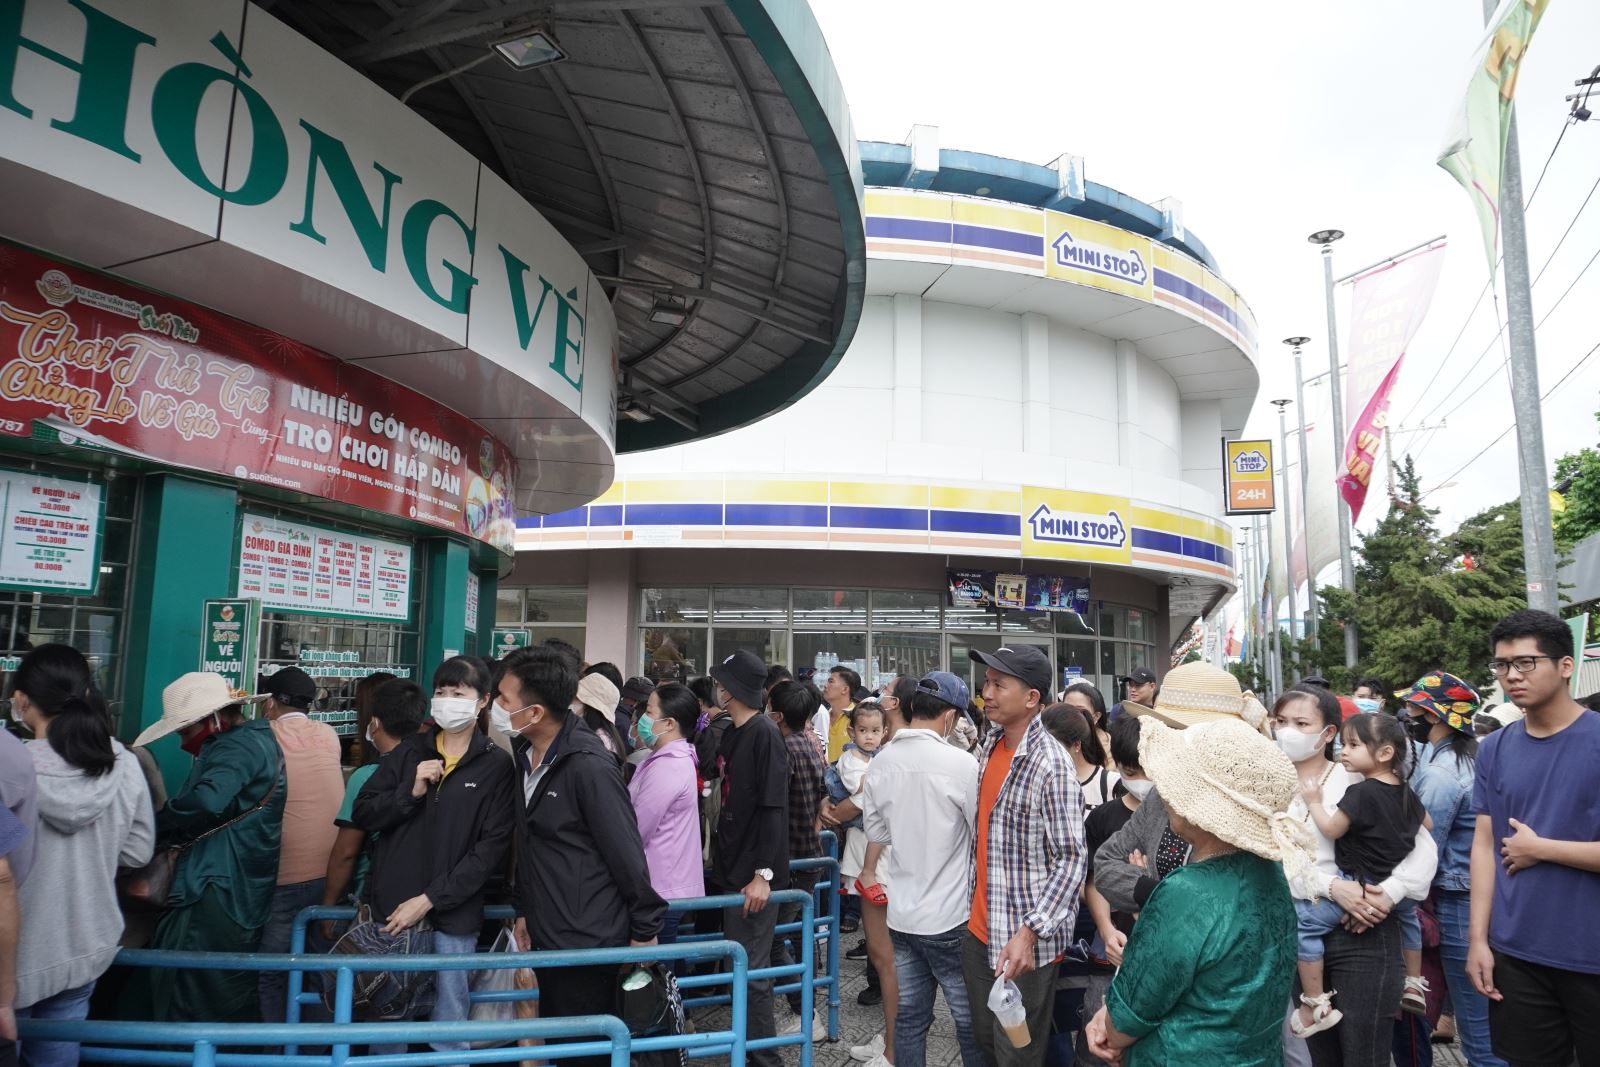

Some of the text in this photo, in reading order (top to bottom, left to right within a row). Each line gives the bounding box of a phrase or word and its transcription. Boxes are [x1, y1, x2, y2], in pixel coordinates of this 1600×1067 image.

[1063, 244, 1139, 277] MINI STOP
[73, 287, 86, 296] DU
[498, 244, 584, 392] VÉ
[1, 303, 269, 416] Chơi Thả Ga
[1, 362, 219, 438] Chẳng Lo Về Giá
[241, 418, 270, 443] Cùng
[291, 383, 460, 465] NHIỀU GÓI COMBO
[284, 420, 460, 496] TRÒ CHƠI HẤP DẪN
[249, 470, 301, 489] suoitien.com
[327, 465, 341, 475] CHO
[341, 469, 357, 479] SINH
[394, 485, 404, 493] CAO
[1236, 488, 1266, 501] 24H
[1040, 517, 1118, 541] MINI STOP
[245, 535, 275, 552] COMBO
[277, 541, 291, 555] GIA
[218, 642, 234, 656] VÉ
[205, 658, 242, 673] NGƯỜI
